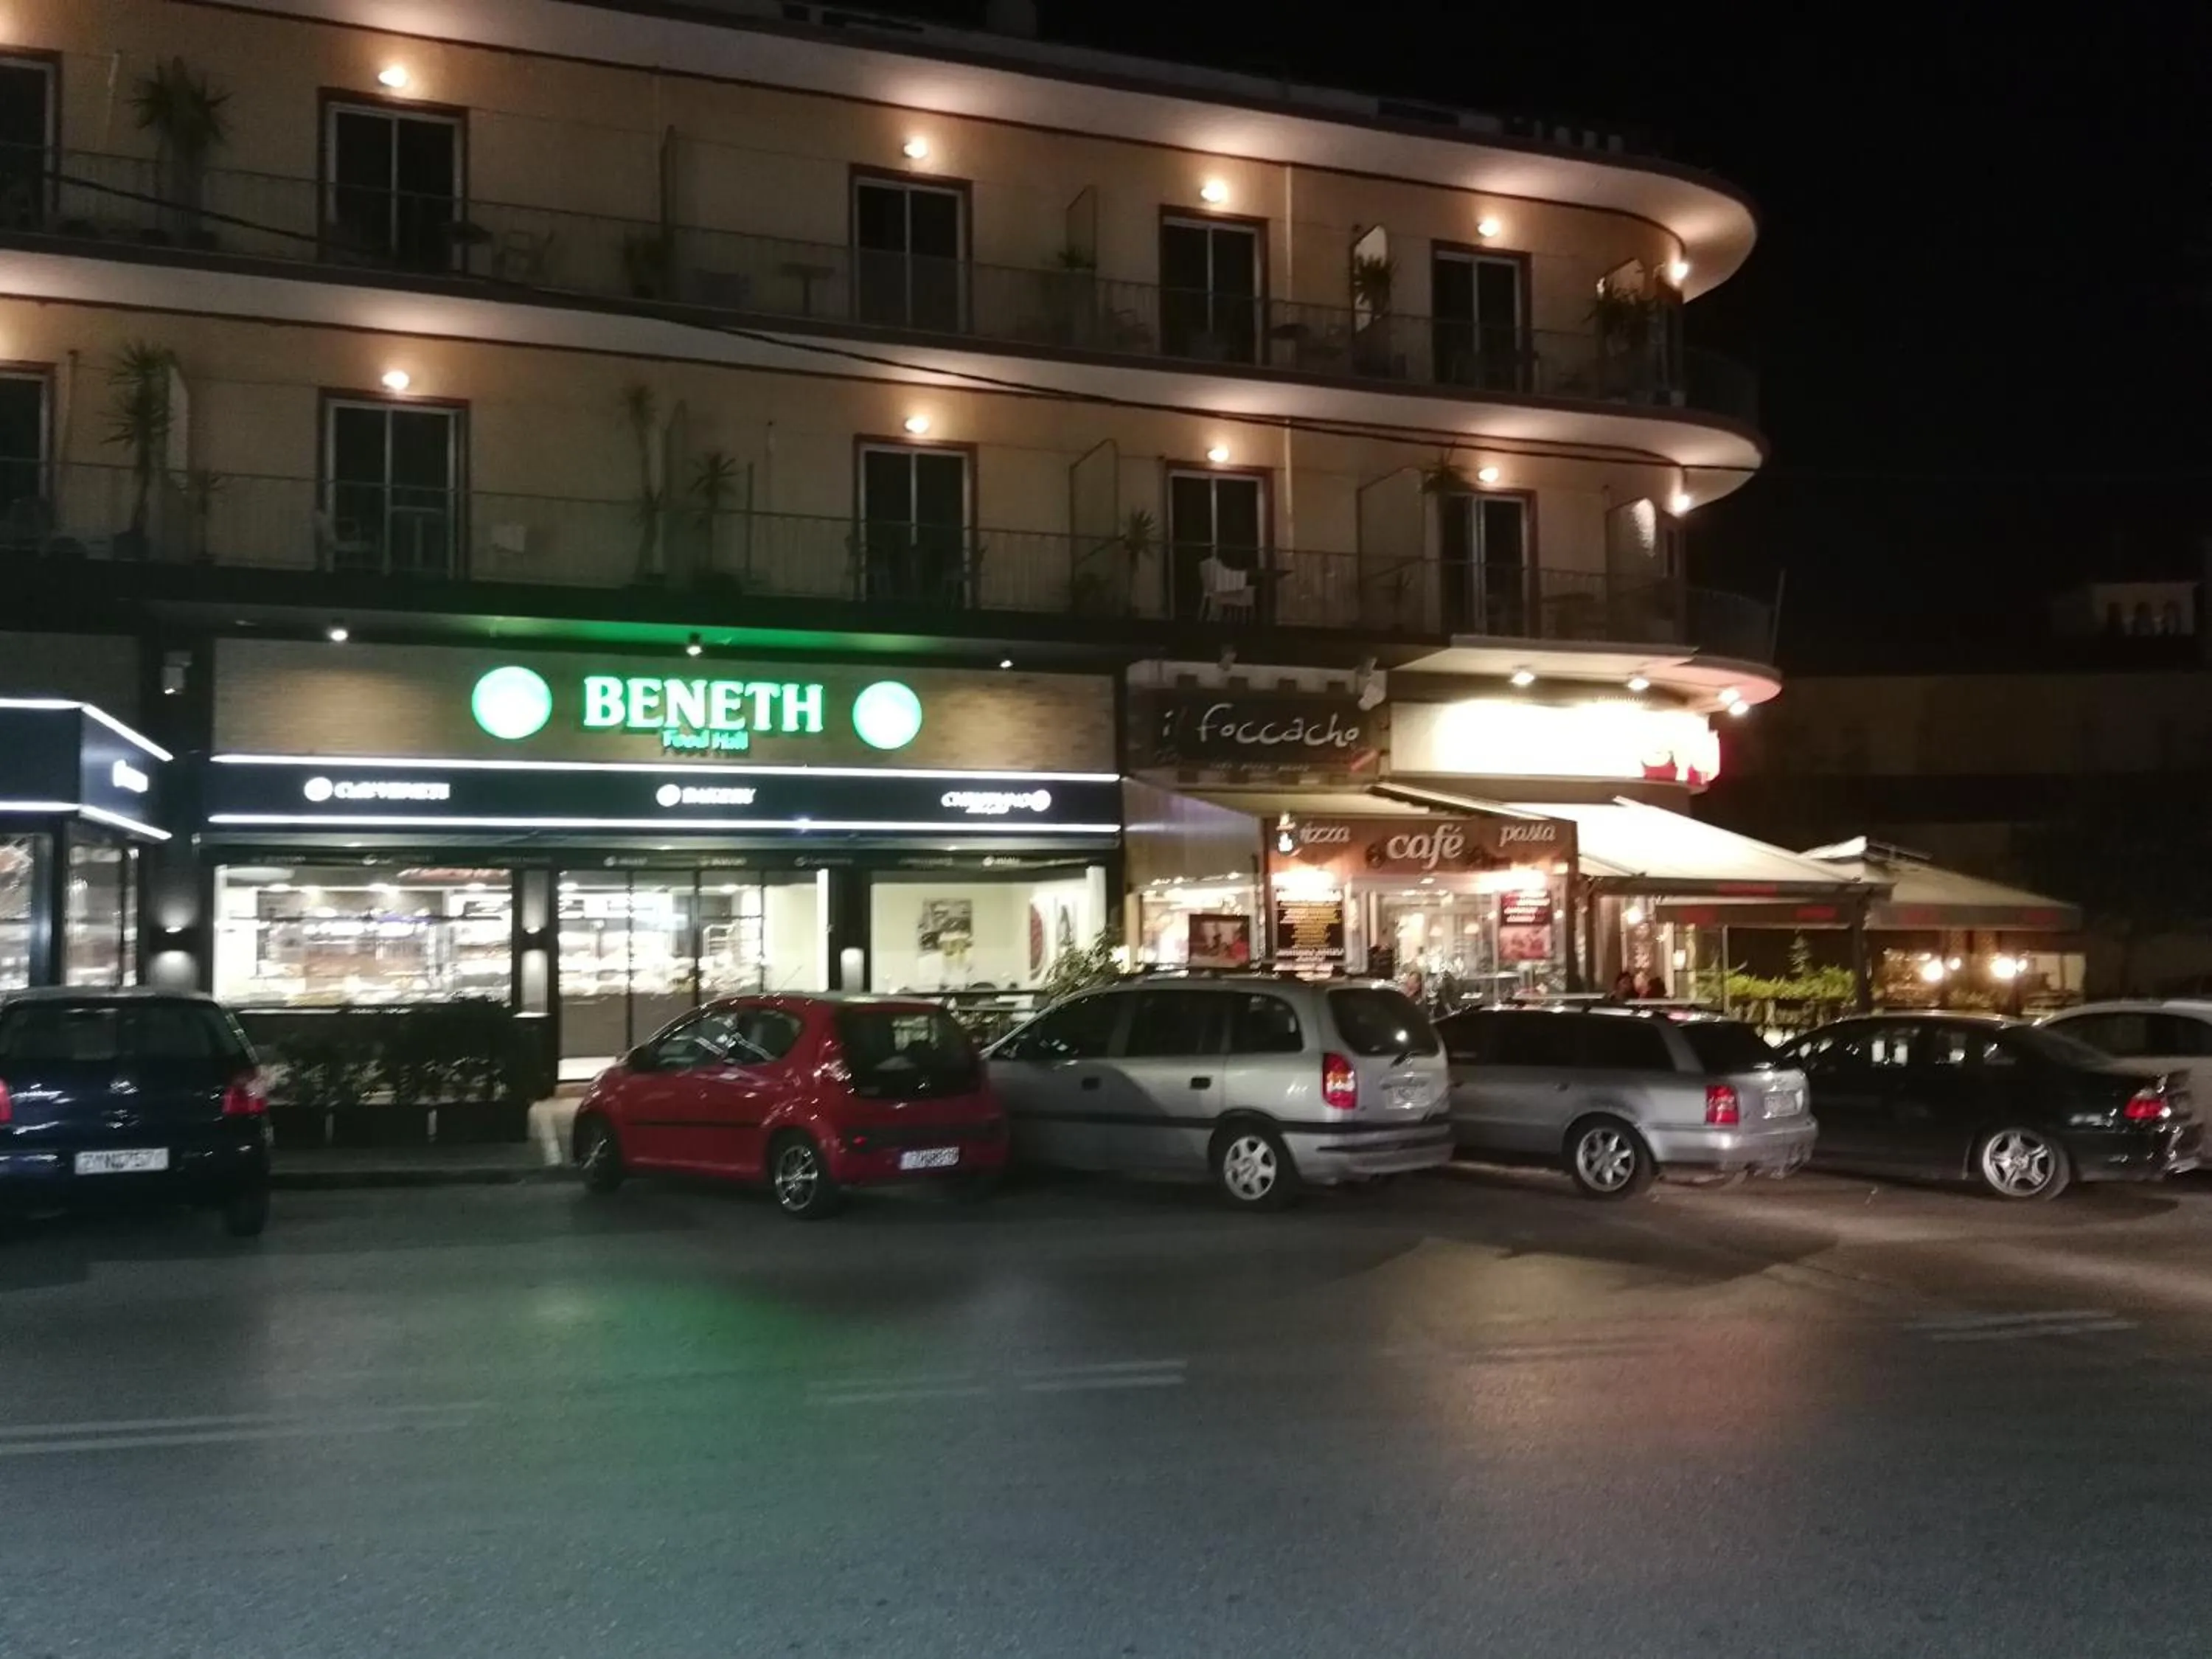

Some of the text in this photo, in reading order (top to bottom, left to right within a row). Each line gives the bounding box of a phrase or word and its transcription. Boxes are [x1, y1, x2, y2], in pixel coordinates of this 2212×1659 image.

[583, 676, 824, 732] BENETH
[1197, 703, 1360, 748] foccacho
[1299, 821, 1556, 869] izza café pasta
